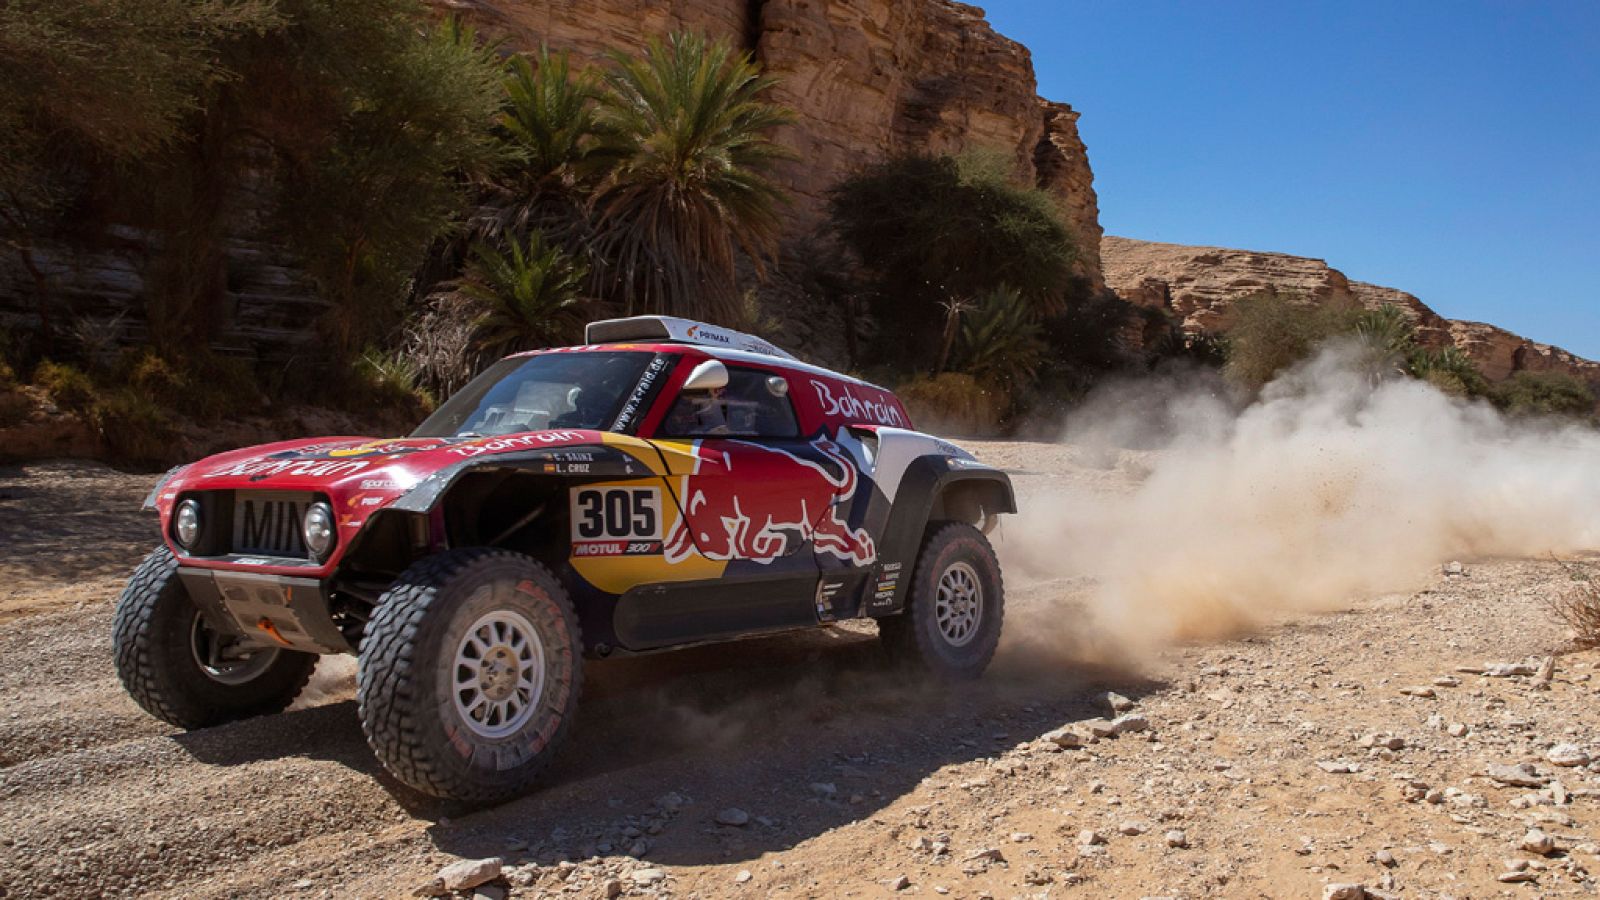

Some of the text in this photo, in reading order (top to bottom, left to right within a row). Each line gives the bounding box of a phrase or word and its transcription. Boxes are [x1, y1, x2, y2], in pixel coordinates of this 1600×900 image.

[699, 330, 730, 345] PRIMAX
[615, 358, 665, 431] www.x-raid.de
[810, 379, 904, 428] Bahrain
[450, 429, 585, 457] Bahrain
[568, 463, 590, 473] CRUZ
[577, 489, 656, 538] 305
[575, 543, 622, 555] MOTUL
